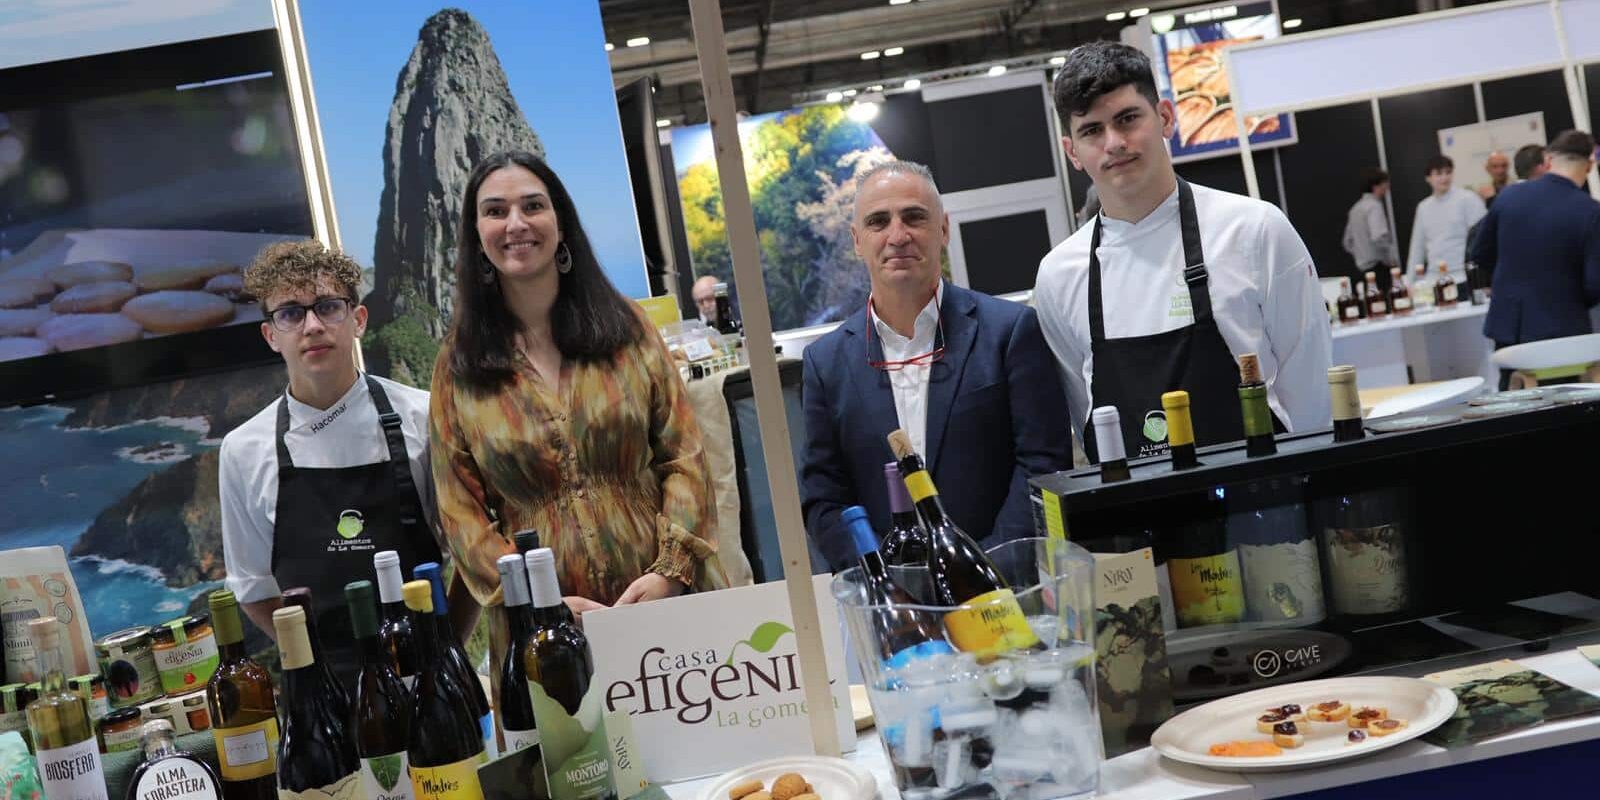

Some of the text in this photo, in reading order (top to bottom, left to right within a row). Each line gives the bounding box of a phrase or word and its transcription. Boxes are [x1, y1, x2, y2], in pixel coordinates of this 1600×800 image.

[311, 402, 347, 433] Hacomar
[1140, 442, 1169, 452] Alimen
[657, 648, 718, 672] casa
[1284, 645, 1321, 663] CAVE
[156, 766, 188, 786] ALMA
